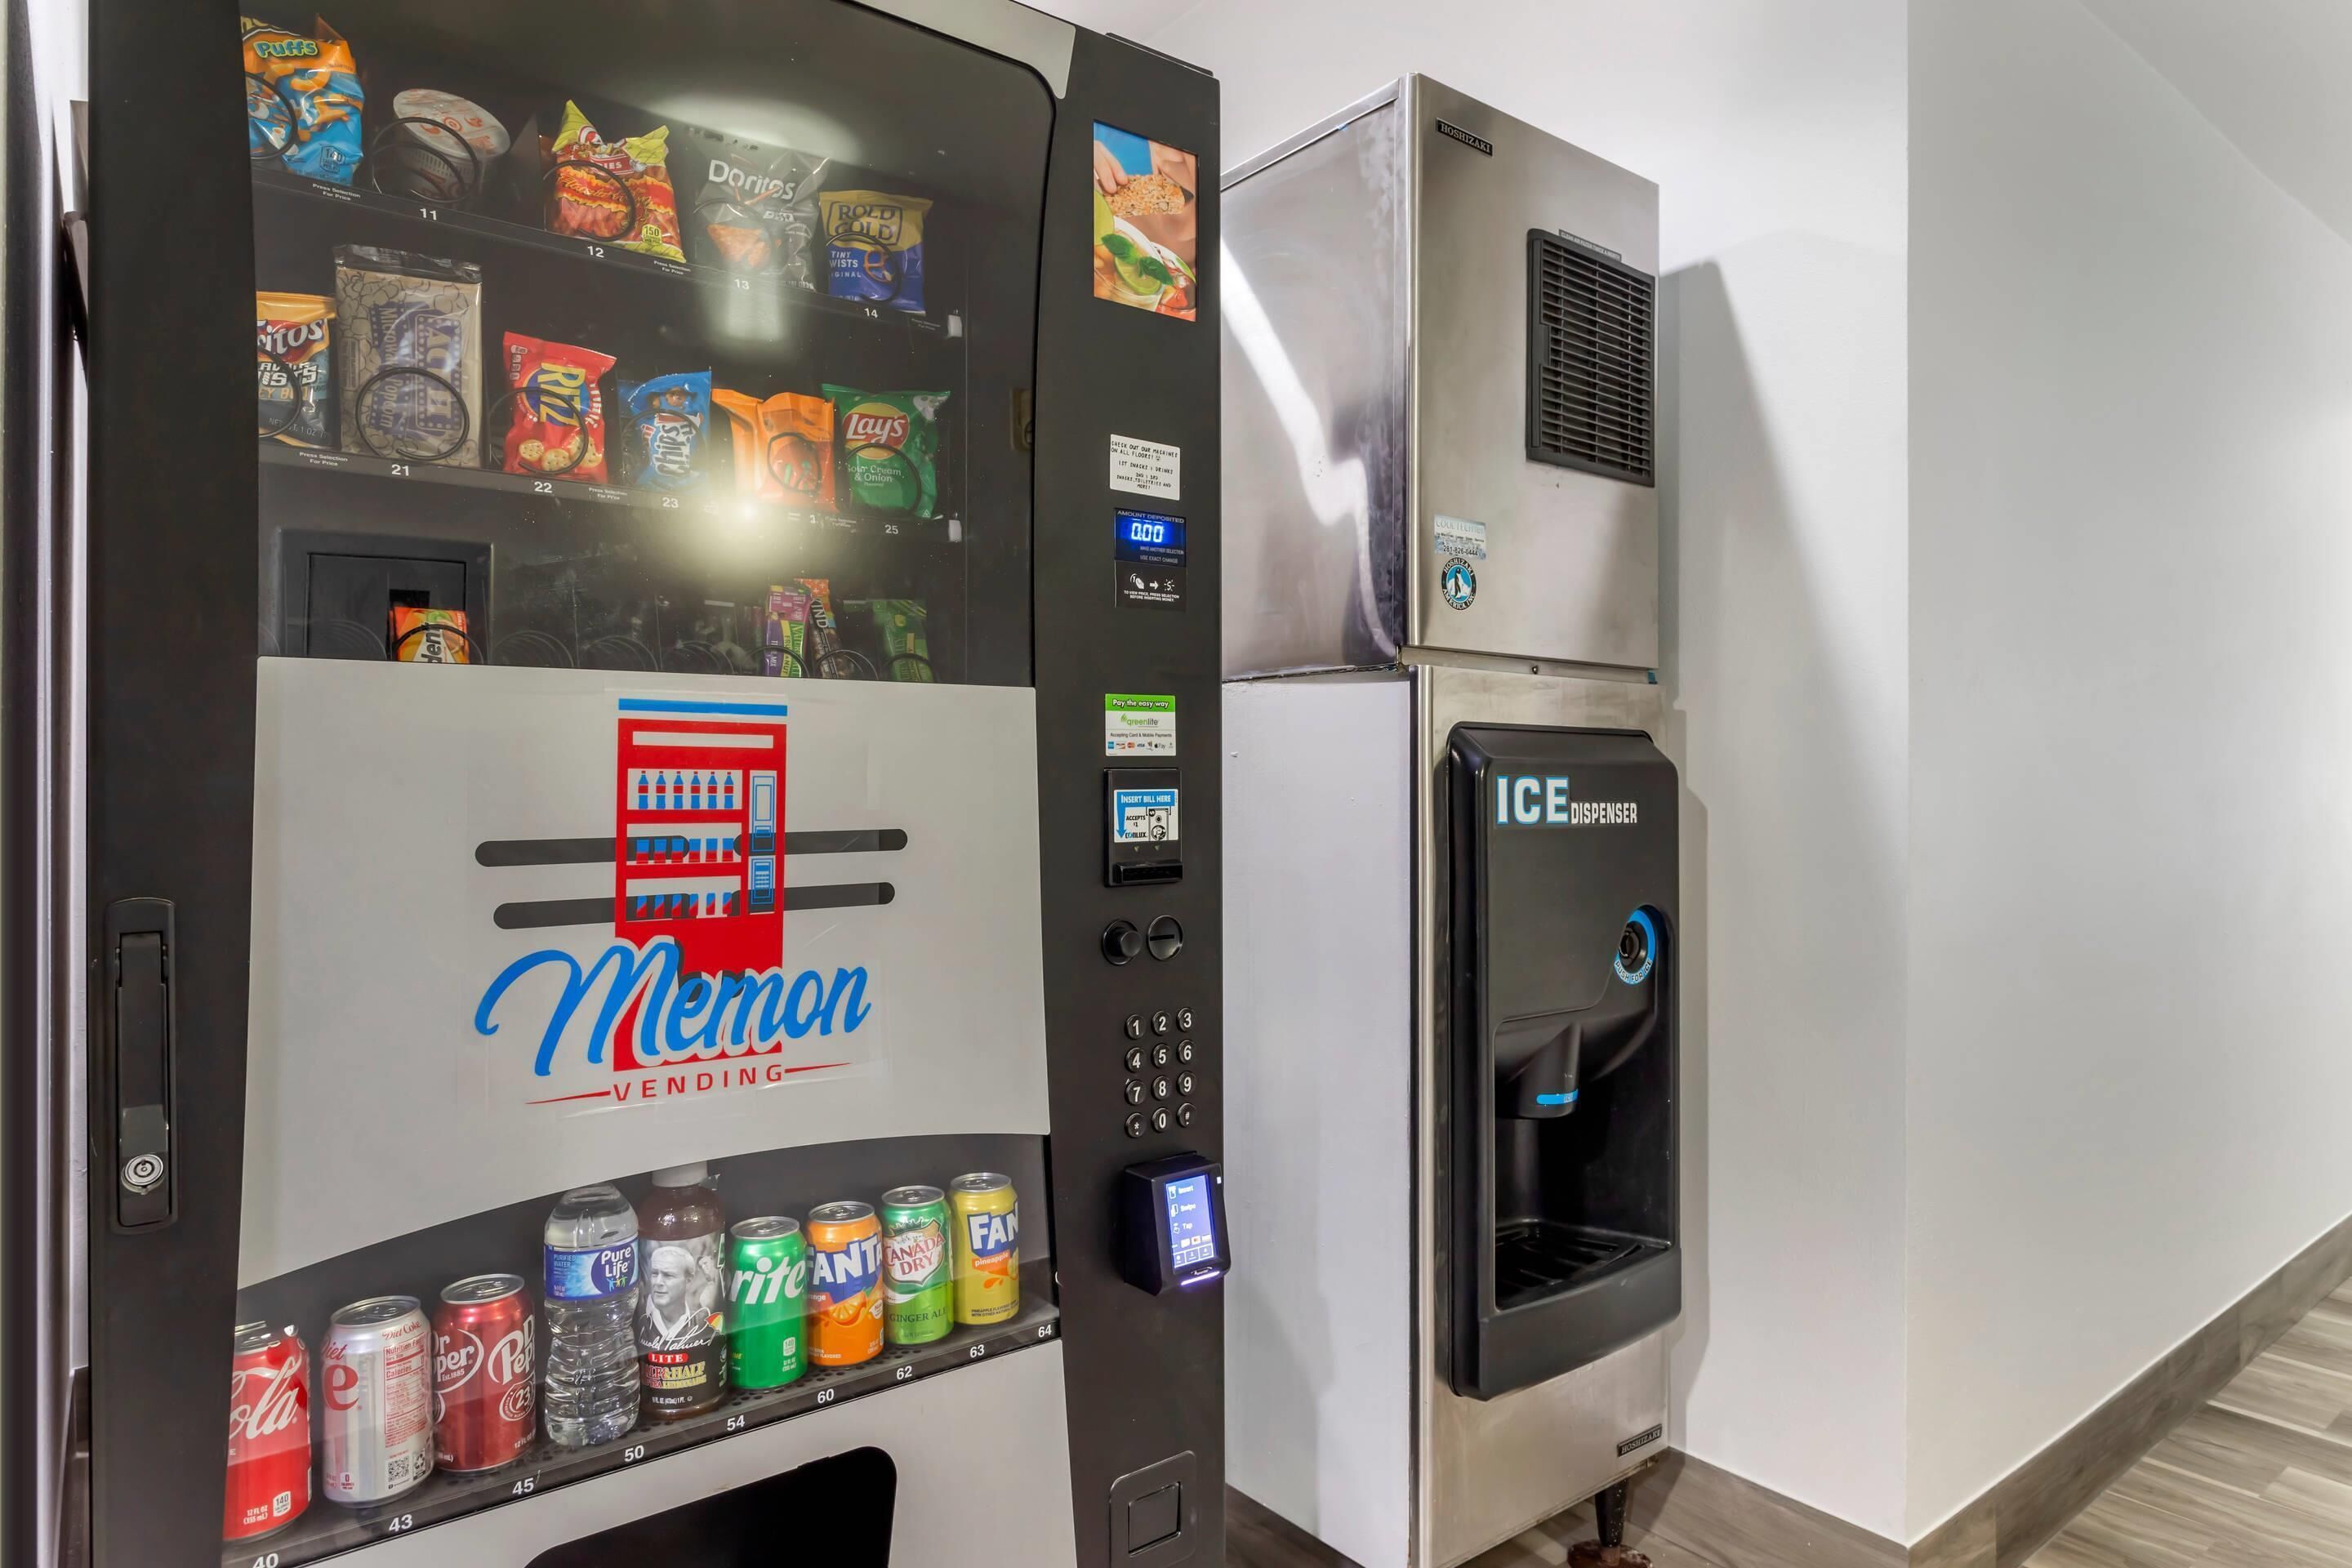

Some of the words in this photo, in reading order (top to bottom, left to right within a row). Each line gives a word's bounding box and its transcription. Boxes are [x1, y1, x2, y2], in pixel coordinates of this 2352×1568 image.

[254, 39, 318, 58] Puffs
[1441, 122, 1490, 153] HOSHIZAKI
[708, 159, 796, 201] Doritos
[313, 183, 331, 192] Press
[332, 188, 361, 198] Selection
[336, 193, 351, 201] Price
[420, 208, 437, 220] 11
[838, 203, 896, 220] ROLD
[645, 225, 660, 236] 150
[835, 220, 894, 240] GOLD
[588, 246, 604, 258] 12
[831, 251, 851, 259] TINY
[669, 264, 691, 272] Selection
[829, 259, 858, 268] WISTS
[734, 278, 750, 290] 13
[865, 308, 879, 318] 14
[537, 363, 586, 427] RITZ
[846, 414, 906, 444] Lay's
[654, 424, 686, 475] Chips
[1153, 448, 1178, 457] MACHINES
[319, 453, 348, 462] Selection
[391, 464, 410, 476] 21
[870, 465, 902, 475] Cream
[1130, 462, 1148, 470] SNACKS
[1156, 467, 1174, 475] DRINKS
[854, 473, 862, 481] &
[864, 473, 893, 482] Onion
[534, 482, 553, 493] 22
[662, 497, 679, 508] 23
[1147, 514, 1184, 523] DEPOSITED
[884, 524, 899, 535] 25
[1131, 523, 1165, 543] 0.00
[1443, 558, 1473, 575] HOSHIZAKI
[1112, 699, 1125, 707] Pay
[1120, 795, 1142, 804] INSERT
[1143, 795, 1156, 803] BILL
[1496, 776, 1569, 825] ICE
[1570, 803, 1637, 824] DISPENSER
[1615, 960, 1629, 980] PUSH
[1632, 972, 1643, 982] FOR
[1644, 959, 1652, 973] ICE
[474, 942, 871, 1076] Memon
[1133, 1020, 1140, 1036] 1
[1159, 1016, 1166, 1031] 2
[1183, 1013, 1192, 1028] 3
[1132, 1053, 1141, 1068] 4
[1158, 1049, 1166, 1065] 5
[1183, 1045, 1192, 1061] 6
[613, 1064, 782, 1102] VENDING
[1133, 1086, 1141, 1102] 7
[1159, 1080, 1166, 1097] 8
[1183, 1076, 1192, 1093] 9
[1159, 1113, 1166, 1129] 0
[1180, 1203, 1196, 1212] Swipe
[1183, 1222, 1193, 1230] Tap
[601, 1247, 631, 1265] Pure
[883, 1233, 945, 1267] CANADA
[900, 1252, 933, 1276] DRY
[975, 1251, 1009, 1267] pineapple
[605, 1261, 628, 1278] Life
[889, 1312, 929, 1323] GINGER
[932, 1307, 947, 1317] ALE
[382, 1329, 403, 1340] Diet
[403, 1321, 421, 1334] Coke
[1038, 1325, 1052, 1337] 64
[385, 1343, 411, 1356] Nutrition
[970, 1344, 985, 1358] 63
[652, 1354, 684, 1363] LITE
[386, 1365, 412, 1379] Calories
[897, 1365, 913, 1379] 62
[817, 1389, 834, 1404] 60
[727, 1415, 745, 1431] 54
[1621, 1429, 1660, 1454] HOSHIZAKI
[624, 1446, 644, 1461] 50
[345, 1474, 350, 1482] 0
[512, 1477, 534, 1494] 45
[276, 1494, 289, 1506] 140
[256, 1512, 268, 1521] mL)
[389, 1514, 412, 1532] 43
[252, 1553, 278, 1568] 40
